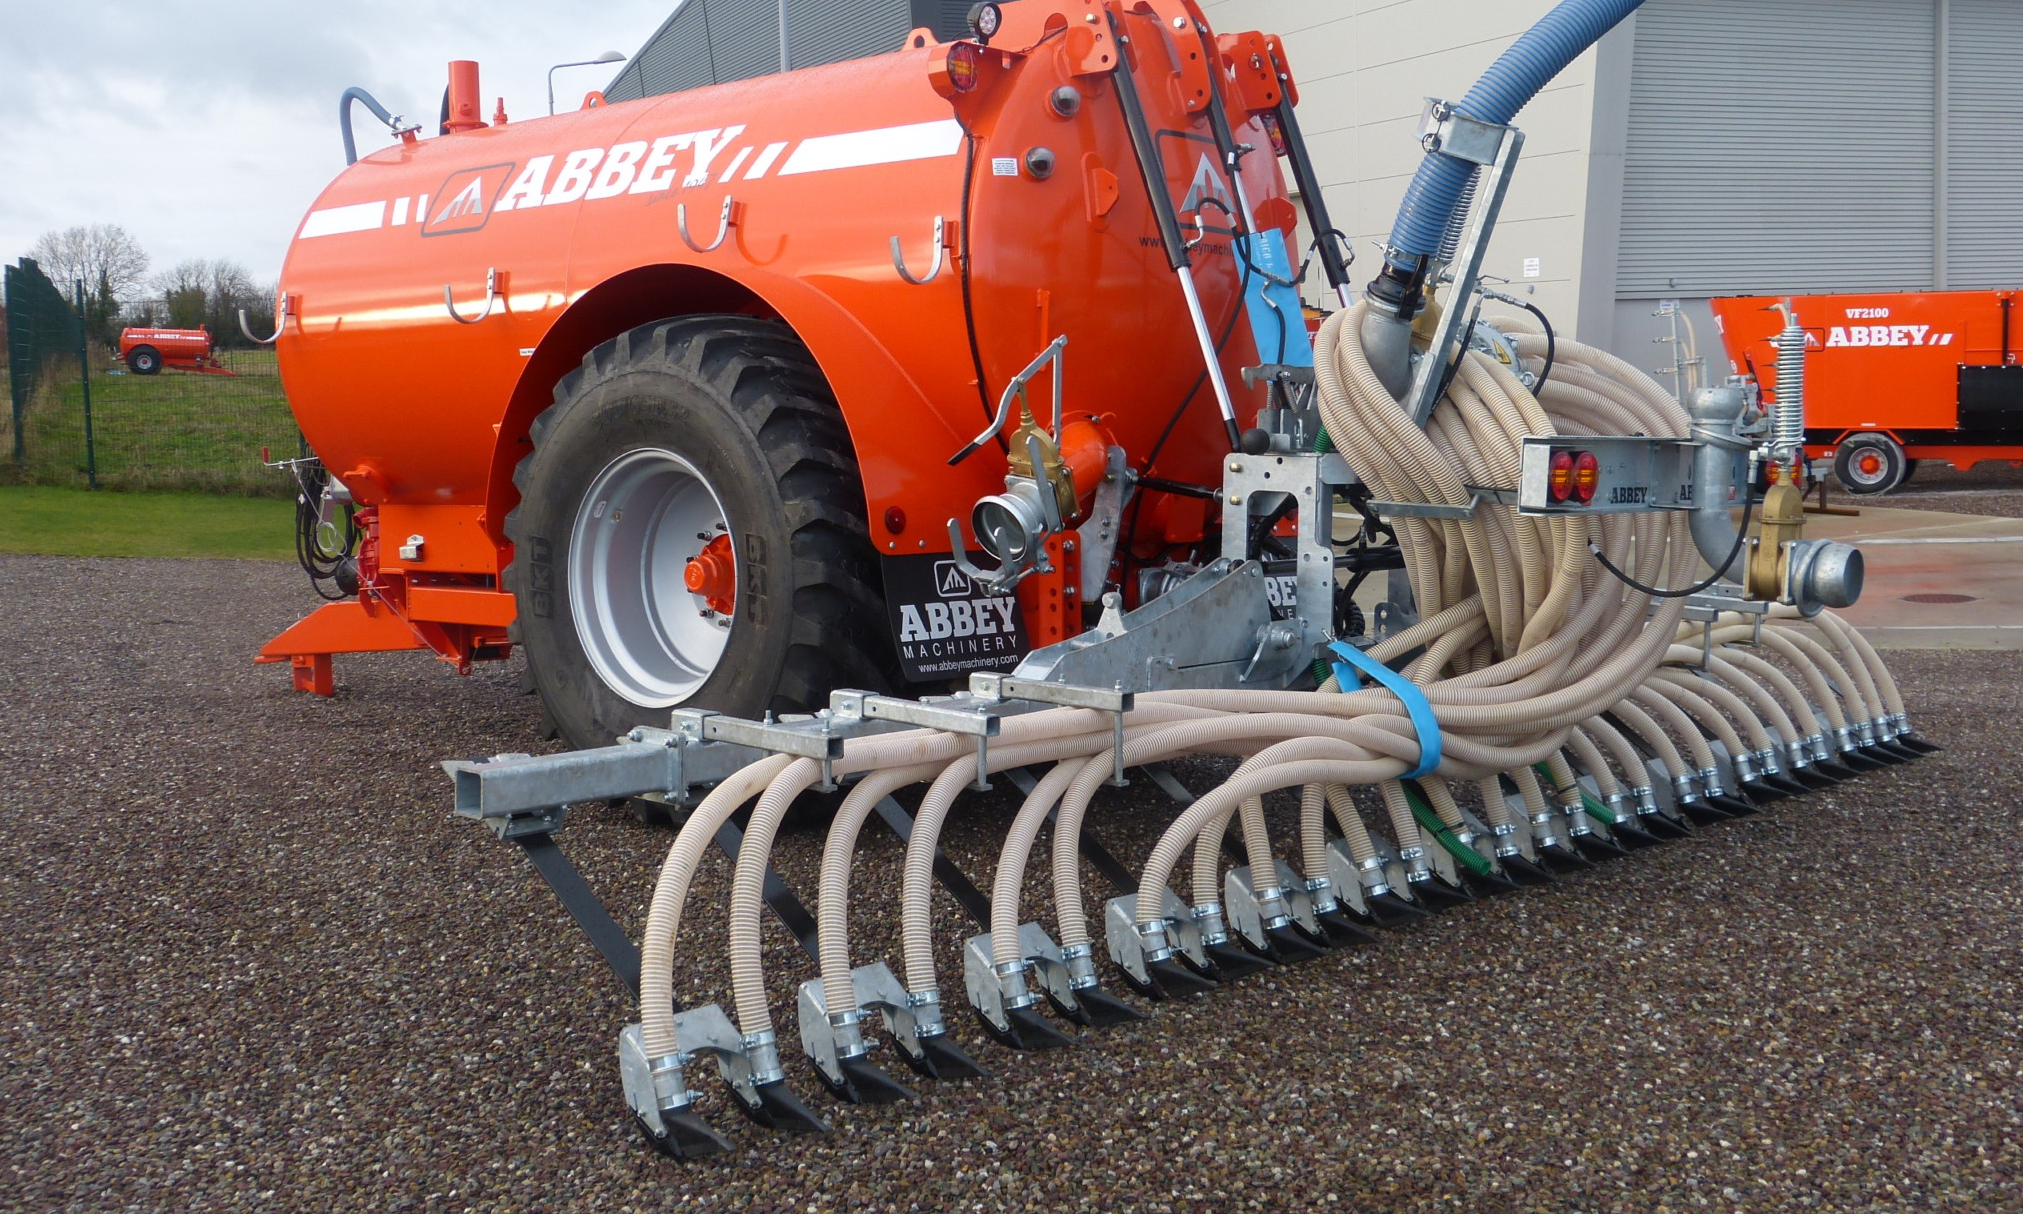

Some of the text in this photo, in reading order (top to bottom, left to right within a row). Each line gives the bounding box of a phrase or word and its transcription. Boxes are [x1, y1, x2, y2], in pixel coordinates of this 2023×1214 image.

[493, 125, 746, 212] ABBEY
[1845, 307, 1890, 319] VF2100
[1826, 325, 1930, 347] ABBEY
[1610, 487, 1648, 504] ABBEY
[900, 596, 1016, 643] ABBEY
[903, 634, 1017, 660] MACHINERY
[917, 653, 1019, 674] www.abbeymachinery.com
